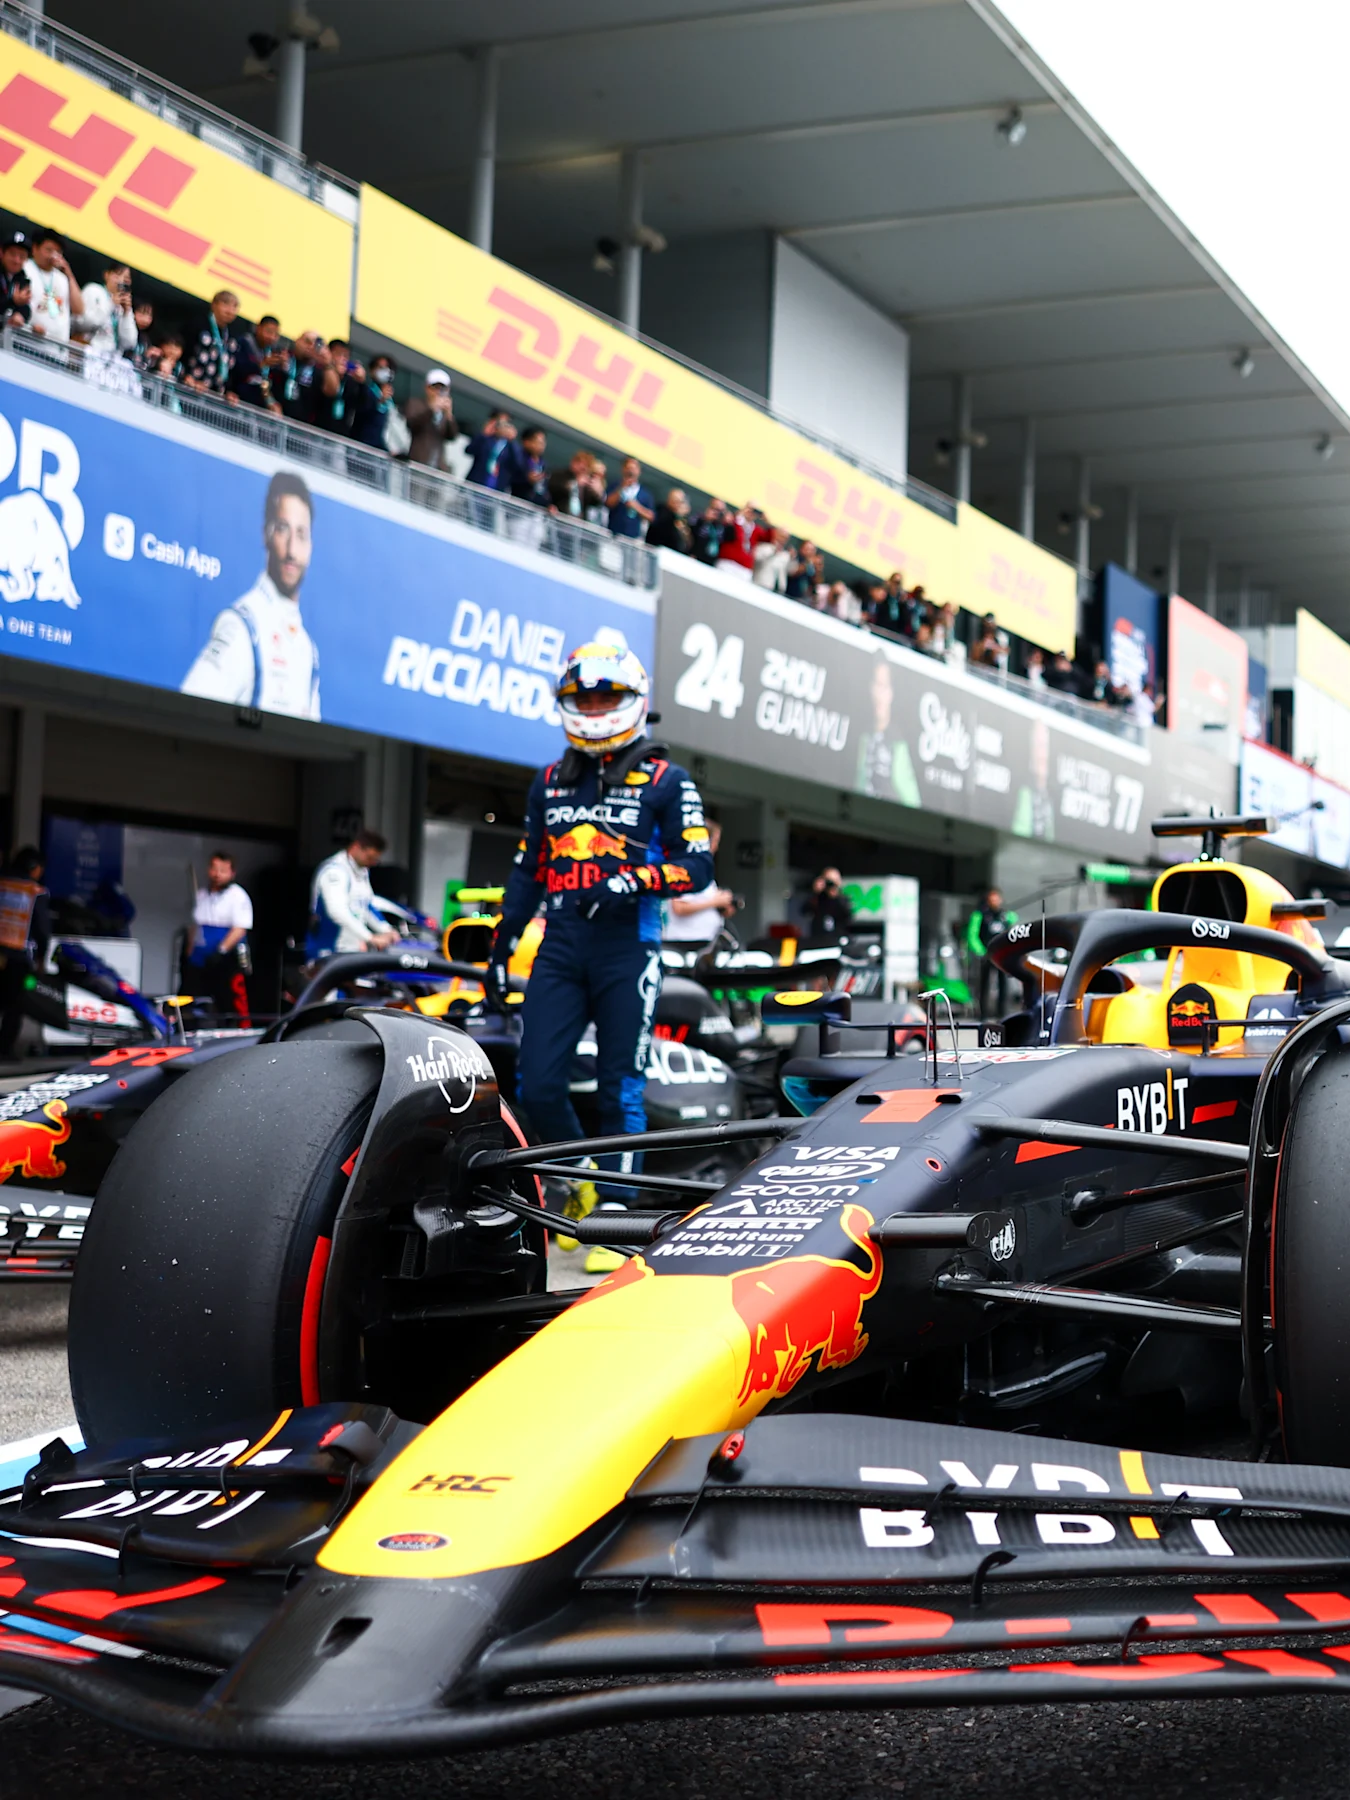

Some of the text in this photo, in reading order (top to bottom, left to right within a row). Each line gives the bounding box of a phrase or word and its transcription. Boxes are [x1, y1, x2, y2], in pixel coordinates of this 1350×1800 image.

[0, 73, 213, 266] HL
[481, 286, 674, 448] DHL
[0, 411, 85, 550] B
[791, 456, 907, 568] DHL
[140, 533, 221, 581] Cash App
[38, 623, 73, 646] TEAM
[449, 598, 565, 676] DANIEL
[674, 622, 745, 719] 24
[759, 648, 827, 704] ZHOU
[755, 689, 850, 752] GUANYU
[545, 804, 640, 827] ORACLE
[546, 862, 580, 894] Red
[1209, 921, 1231, 941] Sui
[1171, 1016, 1191, 1028] Red
[90, 1046, 194, 1067] 11
[406, 1050, 488, 1084] Hard Rock
[1117, 1067, 1189, 1135] BYBIT
[790, 1146, 901, 1161] VISA
[758, 1163, 860, 1178] CDW
[730, 1184, 860, 1197] zoom
[760, 1198, 845, 1209] ARCTIC
[765, 1206, 829, 1216] WOLF
[686, 1217, 823, 1230] PIRELLI
[652, 1242, 756, 1257] Mobil
[408, 1474, 515, 1493] HRC
